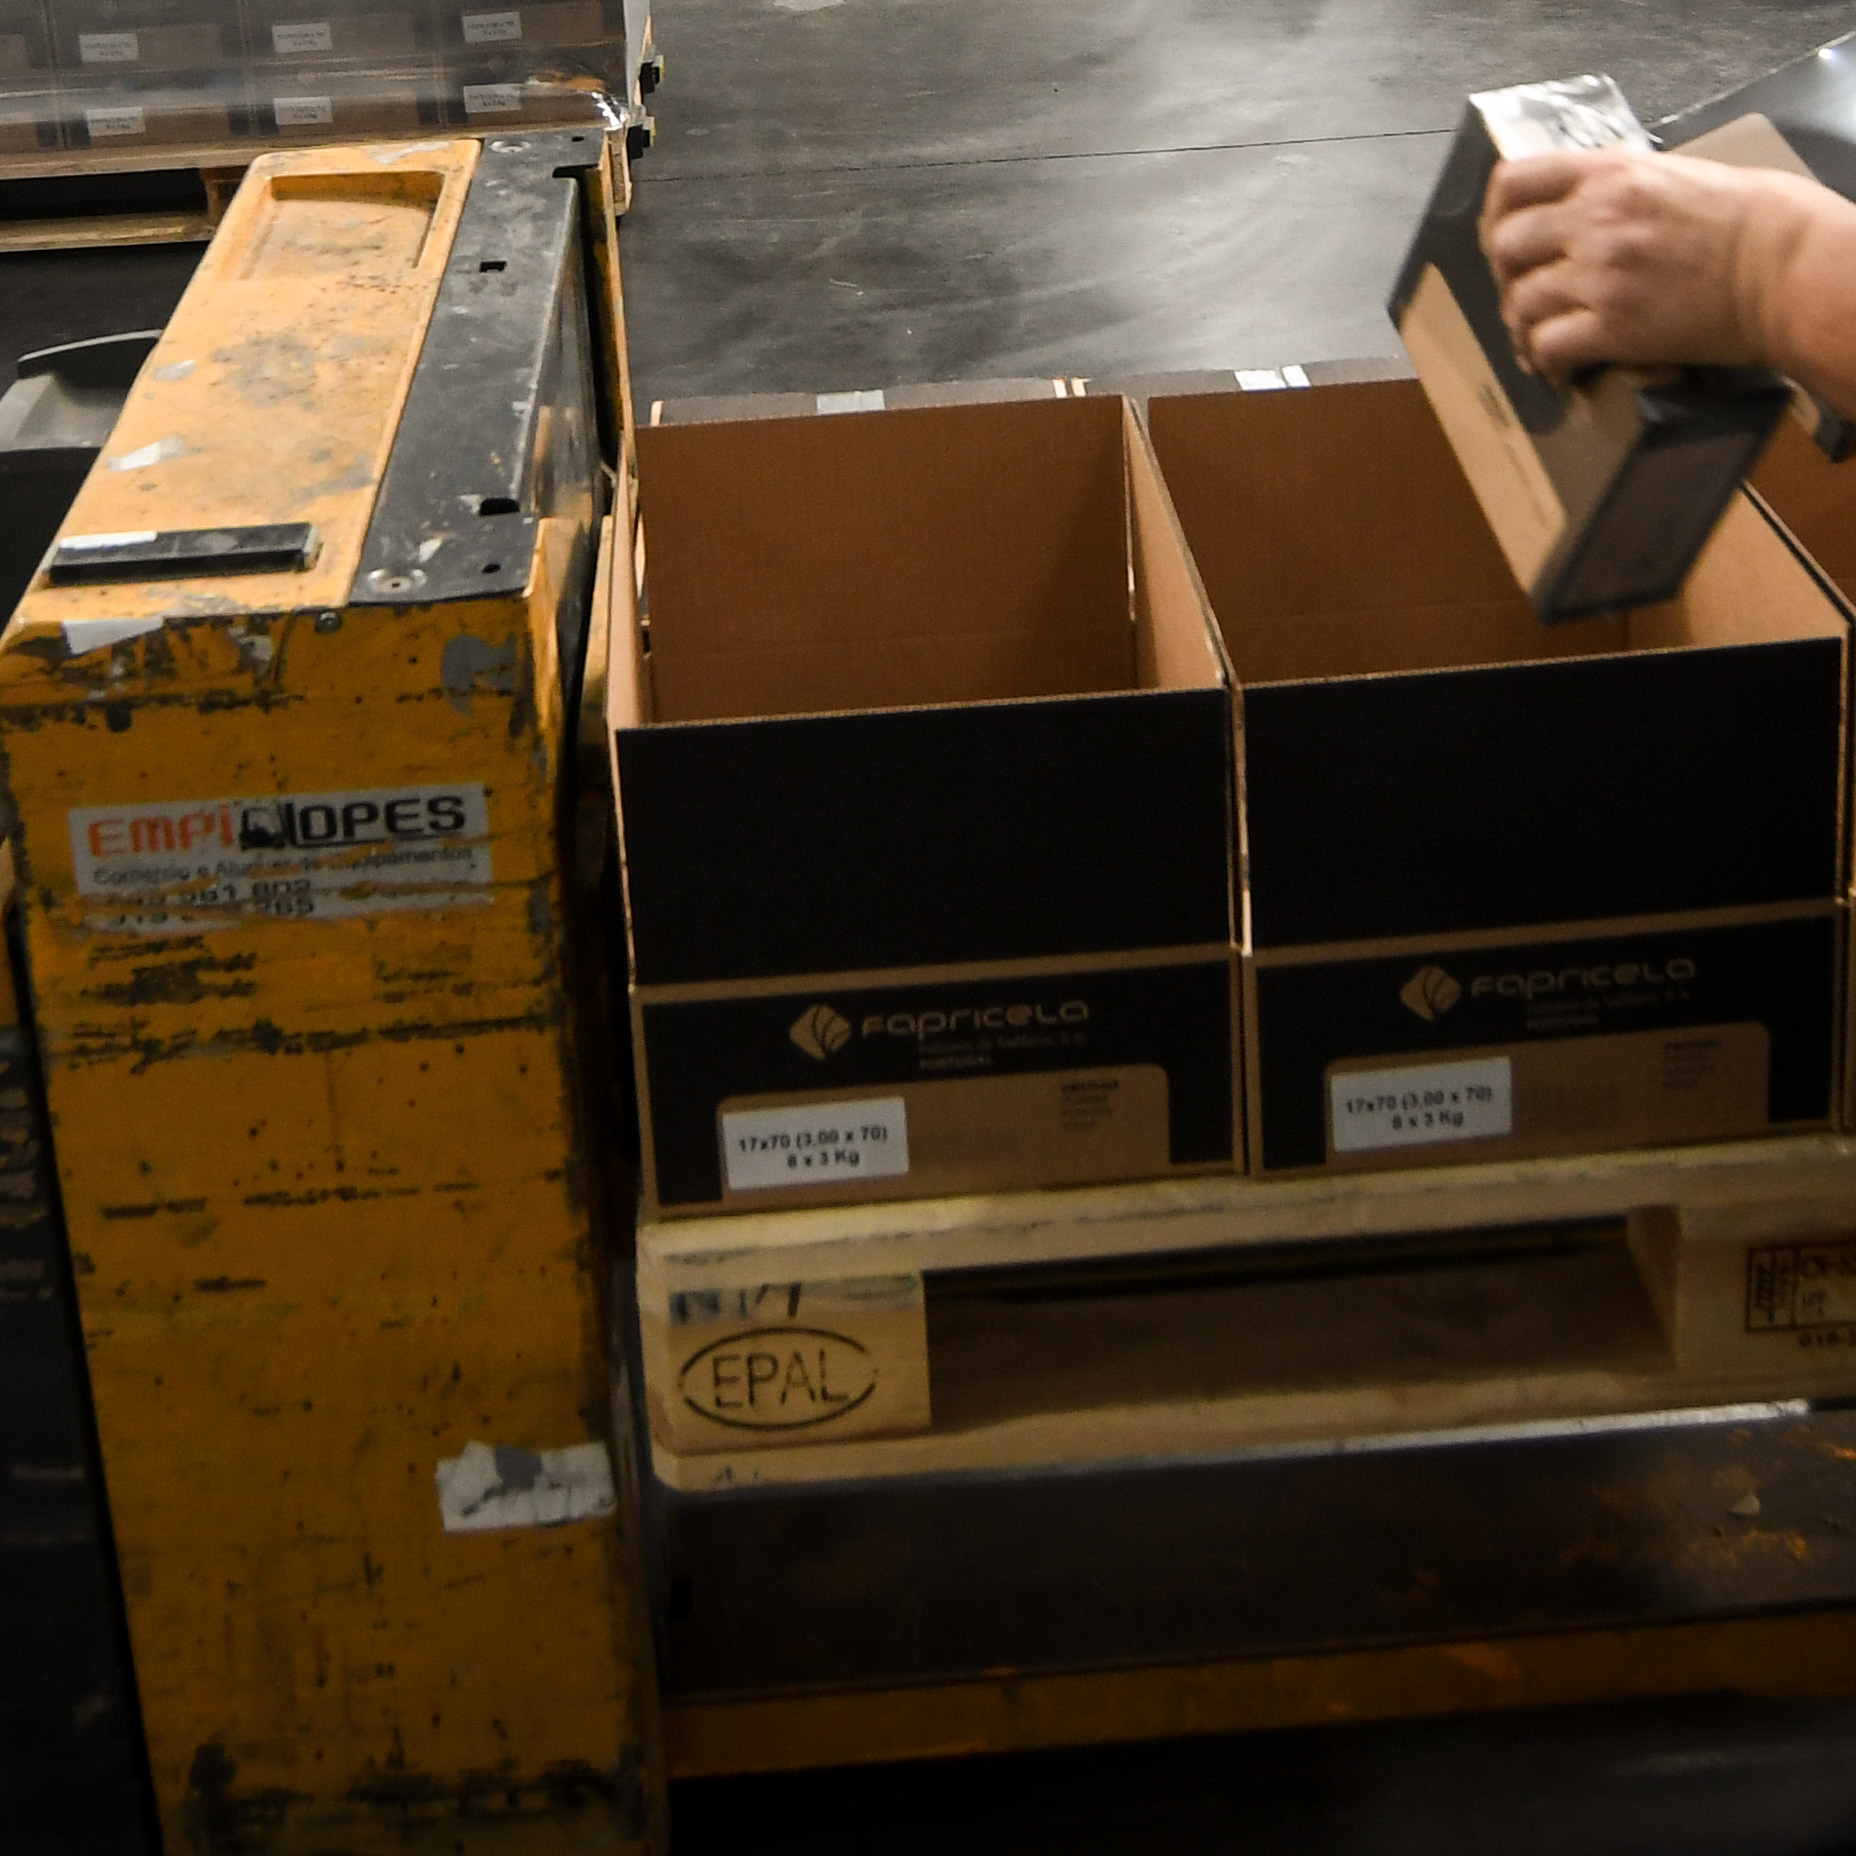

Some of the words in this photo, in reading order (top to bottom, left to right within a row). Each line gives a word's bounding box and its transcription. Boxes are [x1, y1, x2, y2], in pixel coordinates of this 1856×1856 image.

[739, 1133, 792, 1153] 17x70
[846, 1130, 855, 1142] x
[861, 1124, 889, 1142] 70)
[711, 1349, 850, 1410] EPAL
